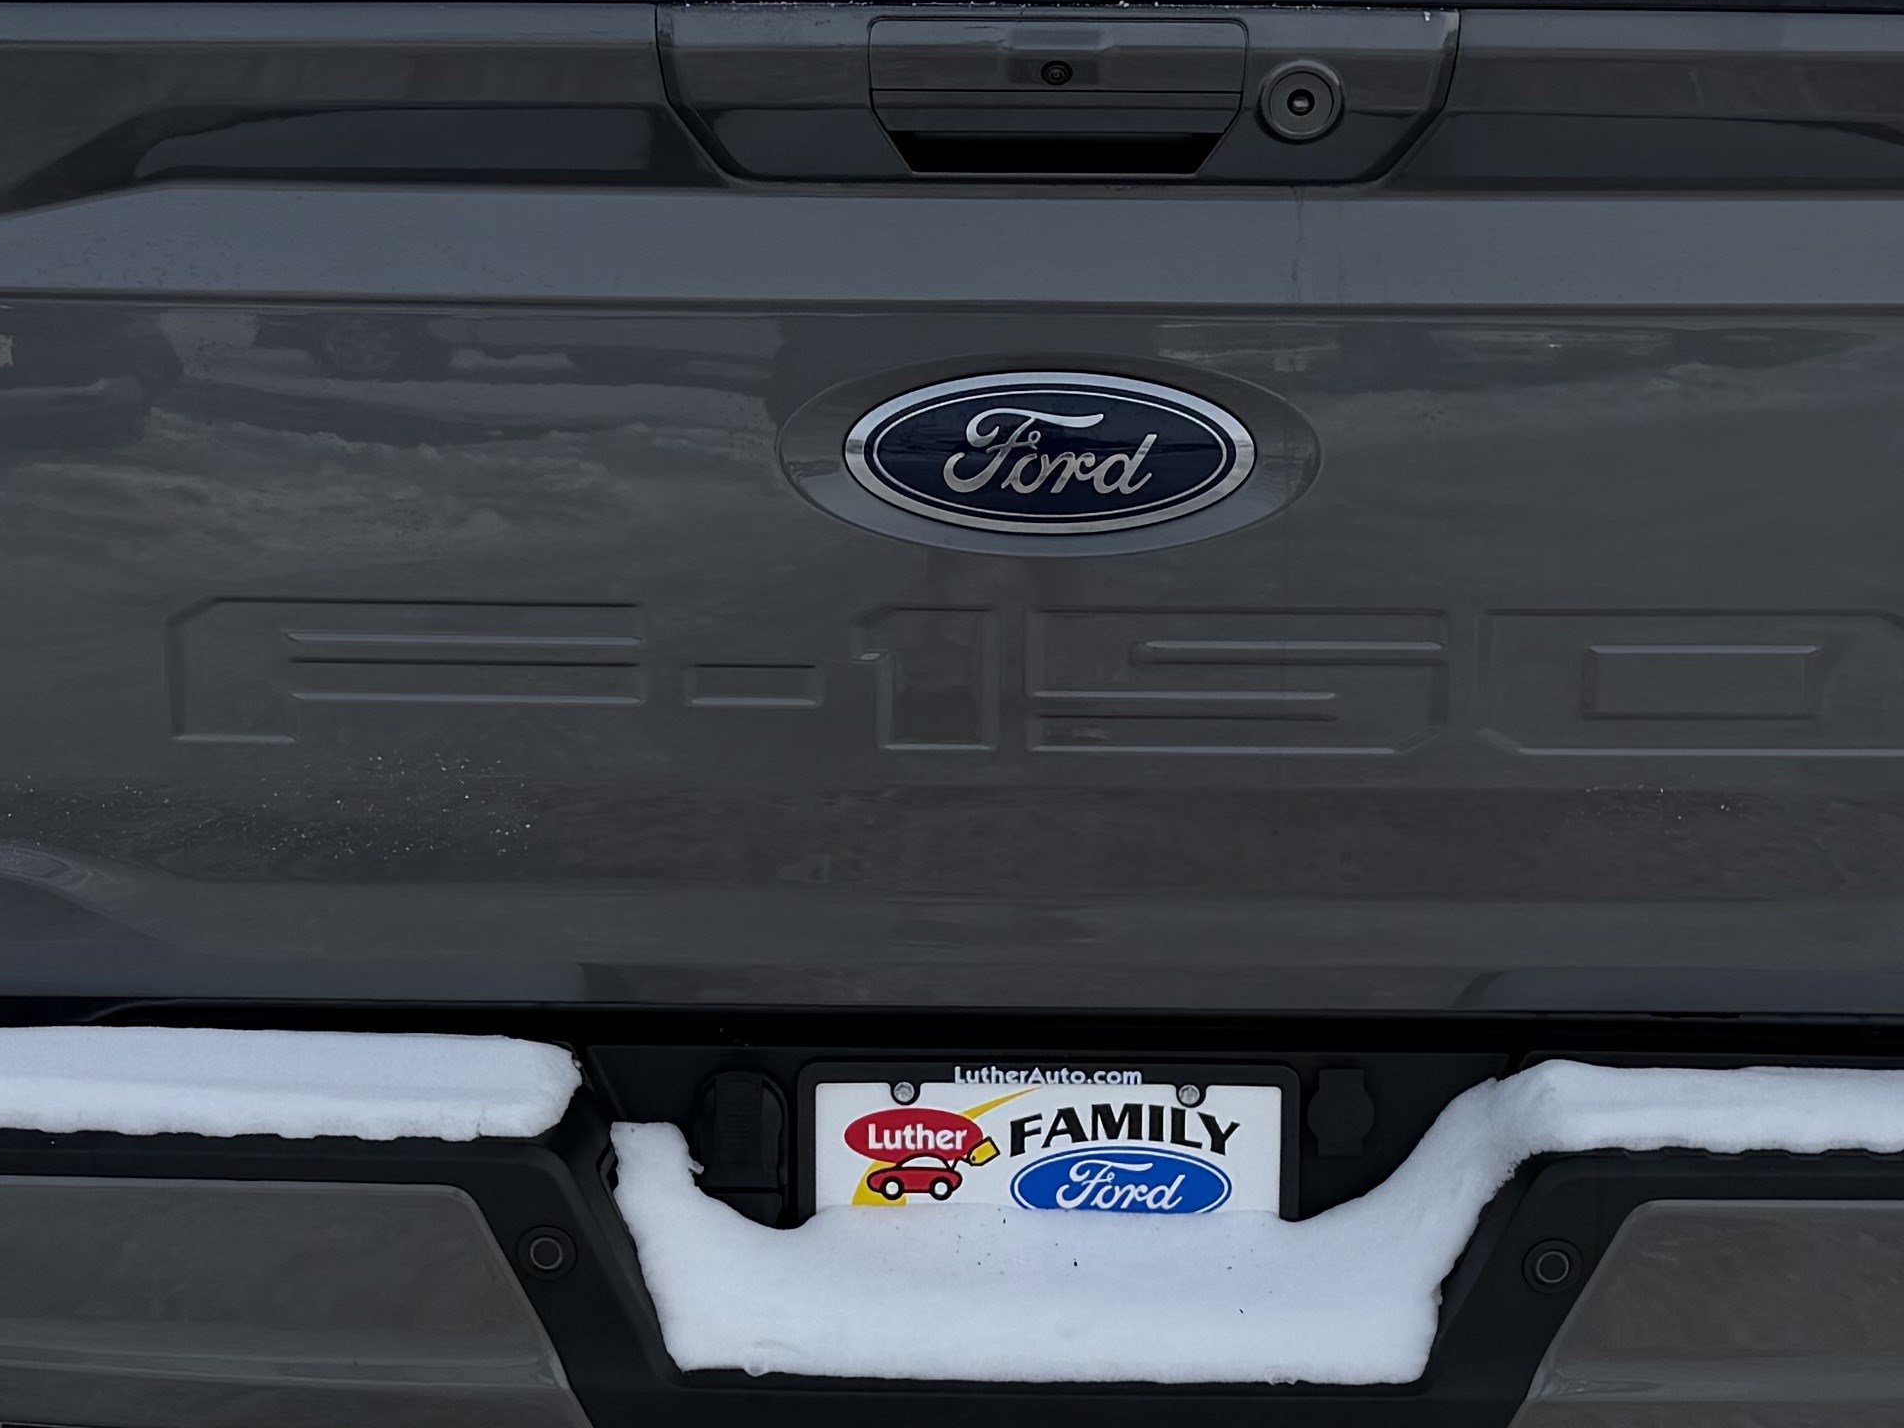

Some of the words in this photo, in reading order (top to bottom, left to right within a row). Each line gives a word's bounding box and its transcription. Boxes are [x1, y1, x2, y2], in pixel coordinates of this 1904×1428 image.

[942, 407, 1158, 495] Ford
[954, 1066, 1142, 1085] LutherAuto.com
[867, 1123, 967, 1152] Luther
[1009, 1103, 1241, 1157] FAMILY
[1055, 1159, 1186, 1210] Ford
